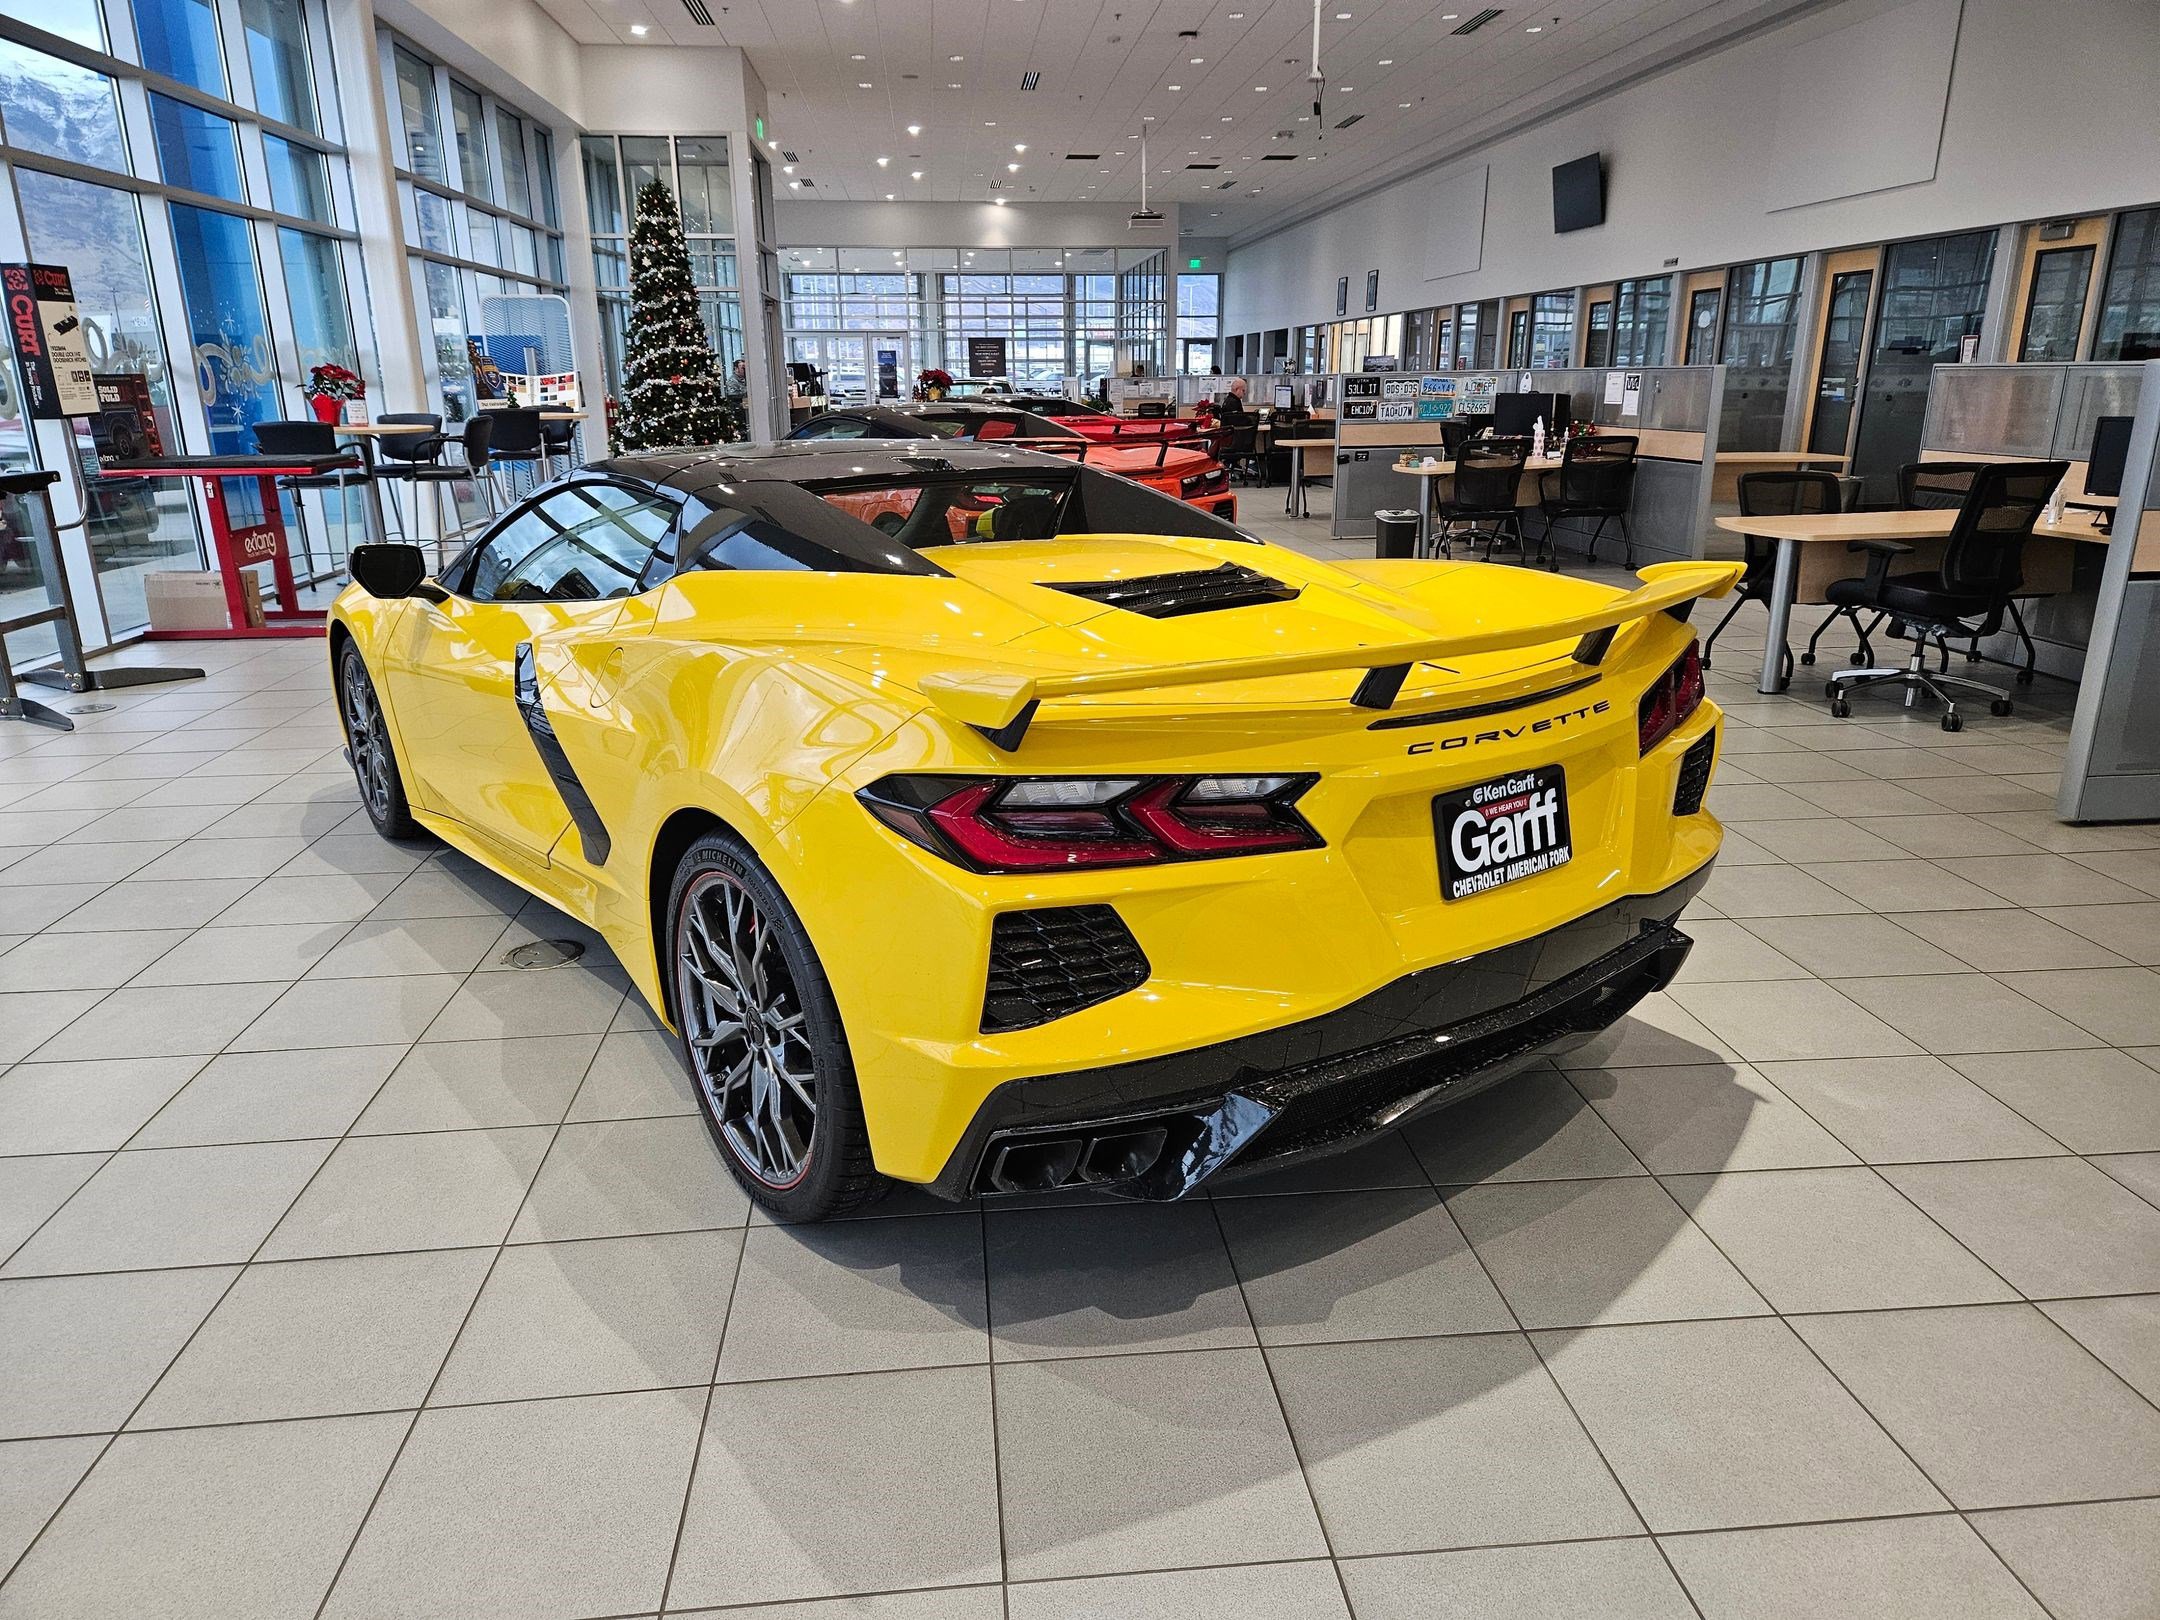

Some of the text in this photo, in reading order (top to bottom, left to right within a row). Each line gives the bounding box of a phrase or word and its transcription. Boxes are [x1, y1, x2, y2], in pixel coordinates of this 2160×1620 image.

[43, 271, 67, 287] CURT
[11, 294, 41, 356] CURT
[97, 386, 118, 394] SOLID
[99, 394, 120, 402] FOLD
[1368, 384, 1377, 394] IT
[244, 530, 277, 556] extang
[1407, 700, 1611, 756] CORVETTE
[1483, 773, 1535, 802] Ken Garff
[1489, 799, 1524, 815] WE HEAR YOU
[1451, 788, 1558, 873] Garff
[702, 850, 744, 875] MICHELIN
[1452, 845, 1570, 898] CHEVROLET AMERICAN FORK
